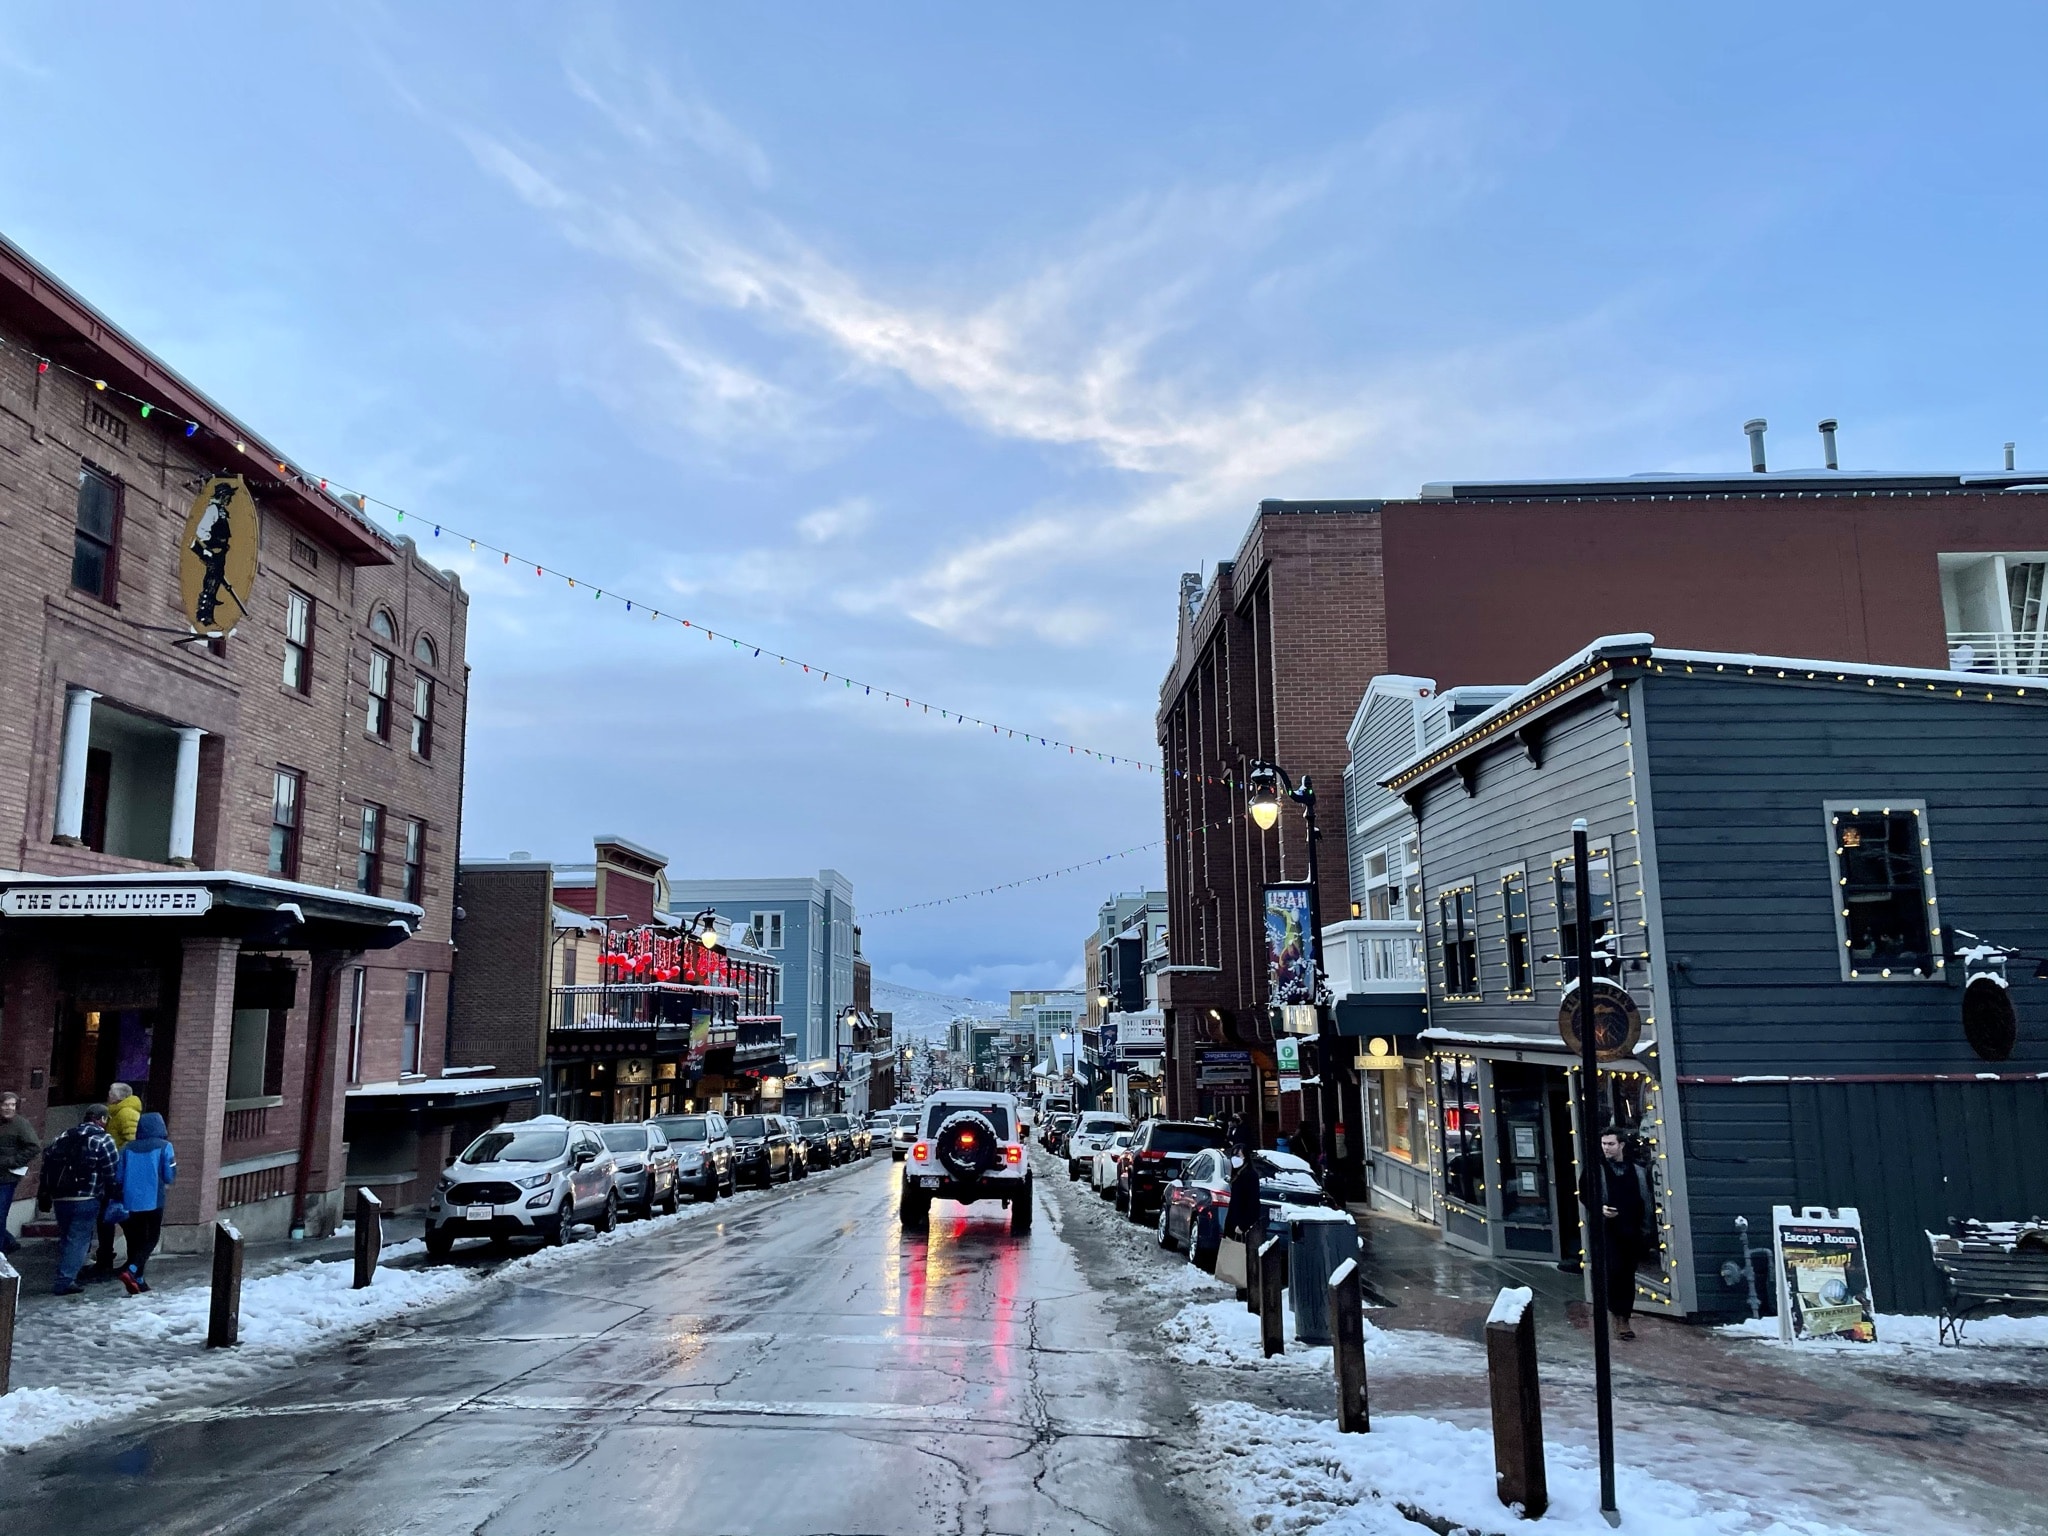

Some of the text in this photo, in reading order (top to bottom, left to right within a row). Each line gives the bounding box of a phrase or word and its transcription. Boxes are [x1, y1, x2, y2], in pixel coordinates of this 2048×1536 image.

[16, 894, 196, 909] THE CLAIMJUMPER
[1267, 891, 1307, 909] UTAH
[1284, 1048, 1292, 1057] P
[1280, 1060, 1287, 1069] 3
[1357, 1058, 1402, 1068] ATHLETA
[1783, 1232, 1857, 1245] Escape Room
[1826, 1253, 1852, 1267] TRAP!
